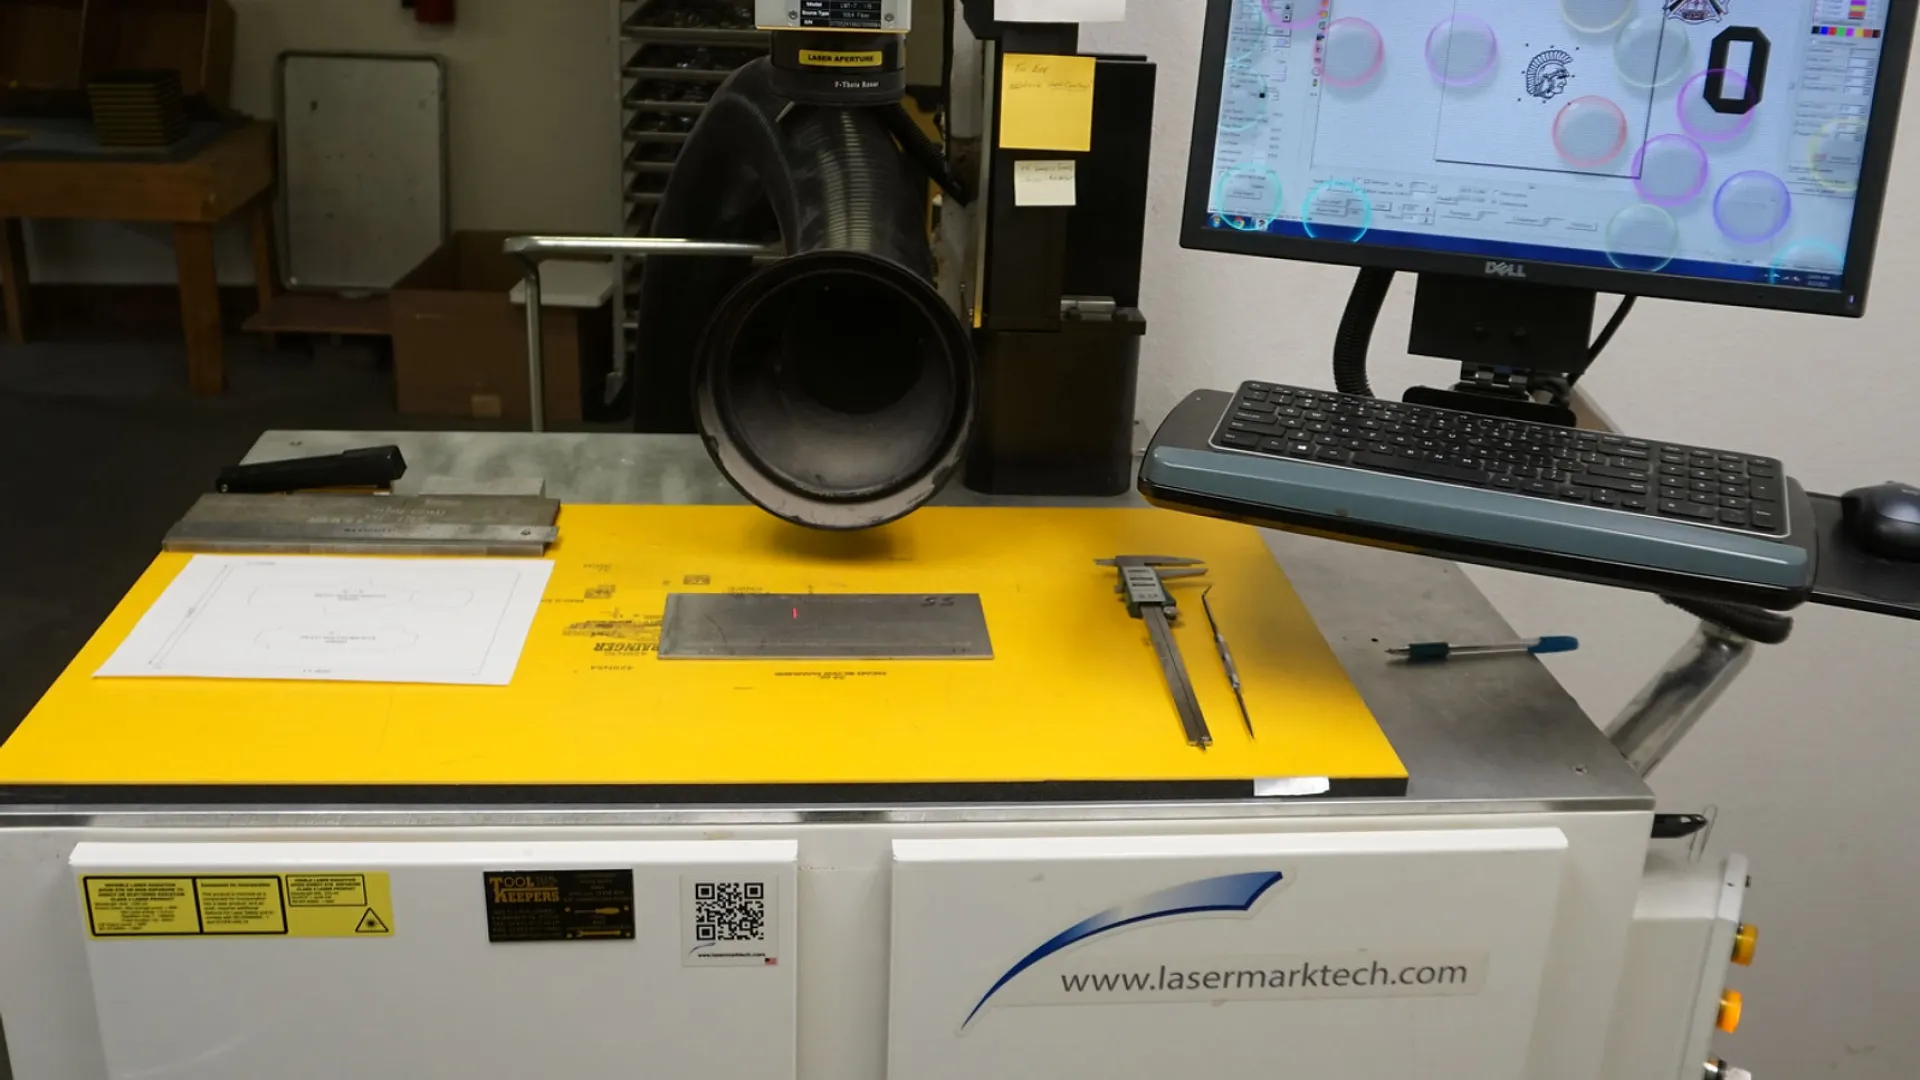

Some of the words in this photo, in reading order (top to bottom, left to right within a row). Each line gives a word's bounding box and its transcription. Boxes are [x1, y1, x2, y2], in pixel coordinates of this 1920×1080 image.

[1485, 261, 1526, 277] DELL
[592, 642, 659, 653] RAINGER
[489, 876, 535, 891] TOOL
[495, 888, 560, 903] KEEPERS
[1060, 960, 1467, 992] www.lasermarktech.com
